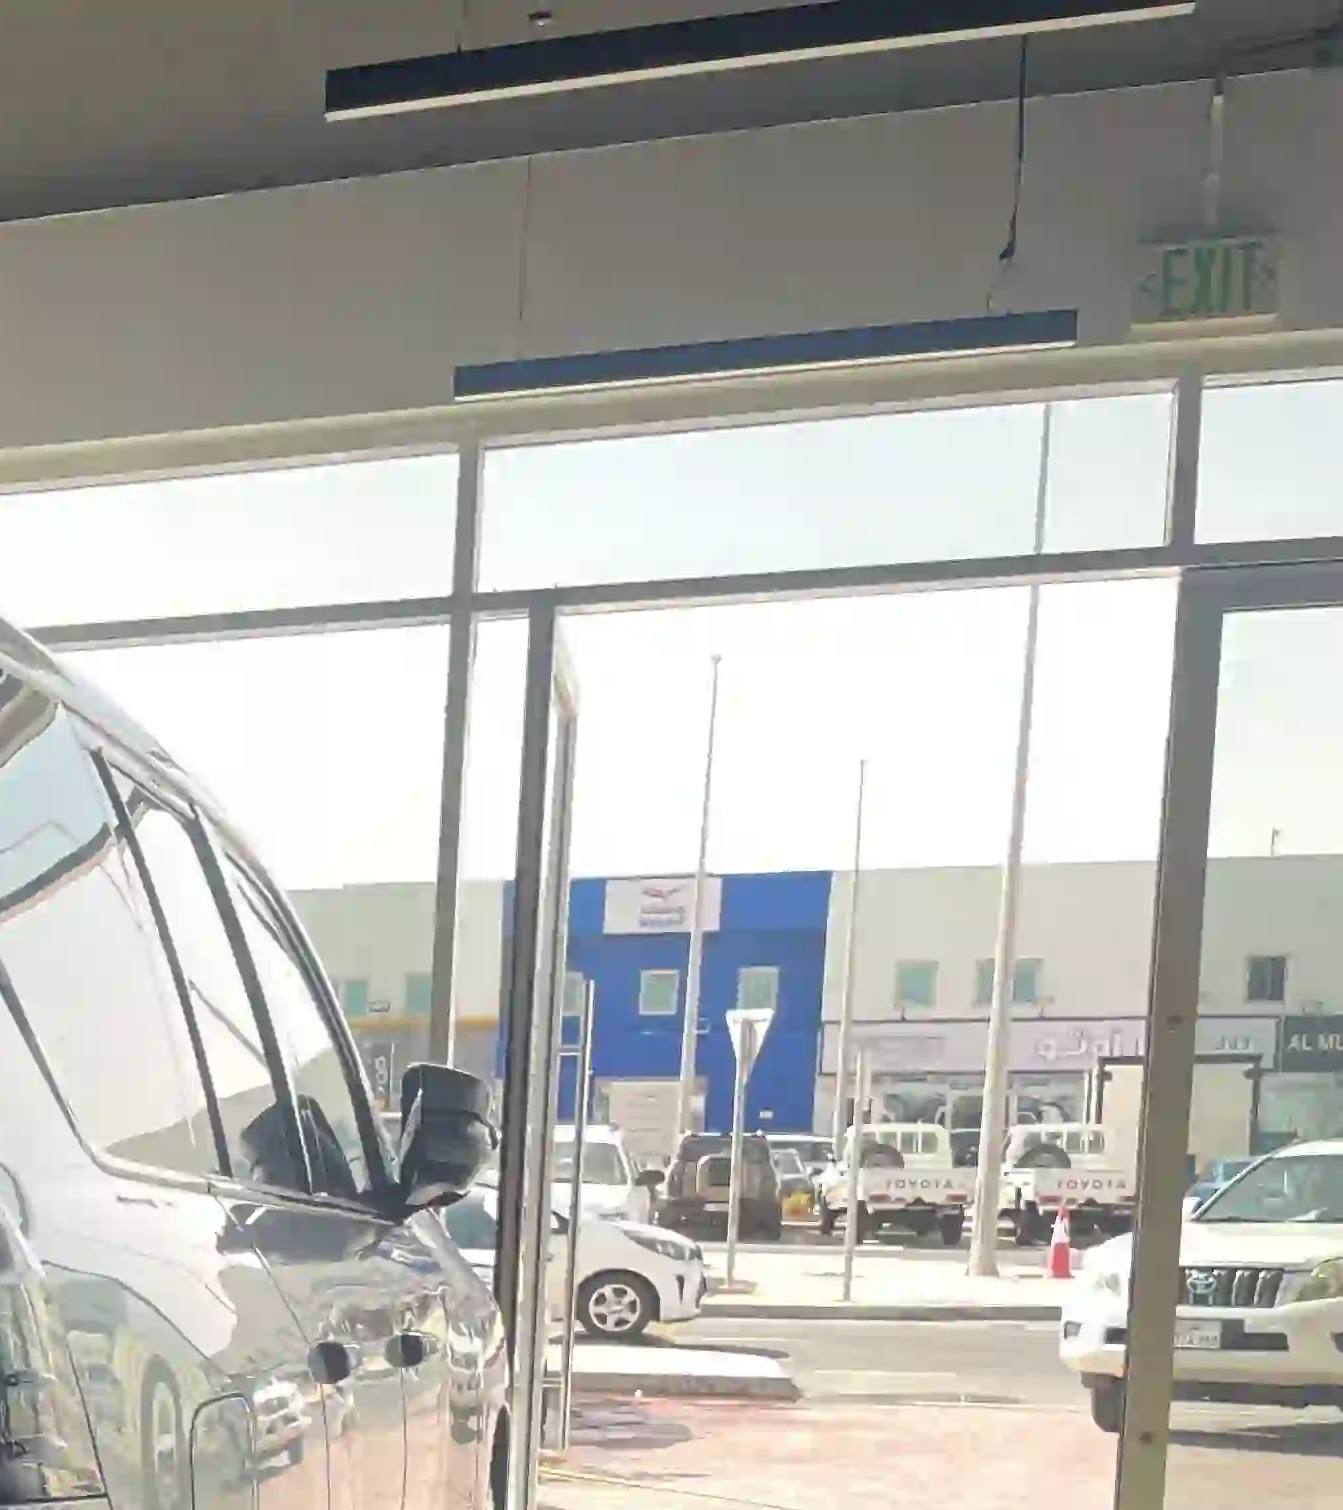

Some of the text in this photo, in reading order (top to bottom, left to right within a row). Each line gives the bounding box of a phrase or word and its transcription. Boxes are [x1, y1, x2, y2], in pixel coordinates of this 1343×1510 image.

[1160, 238, 1263, 316] EXIT
[1288, 1033, 1312, 1051] AL
[885, 1178, 954, 1190] TOYOTA
[1056, 1178, 1127, 1190] TOYOTA
